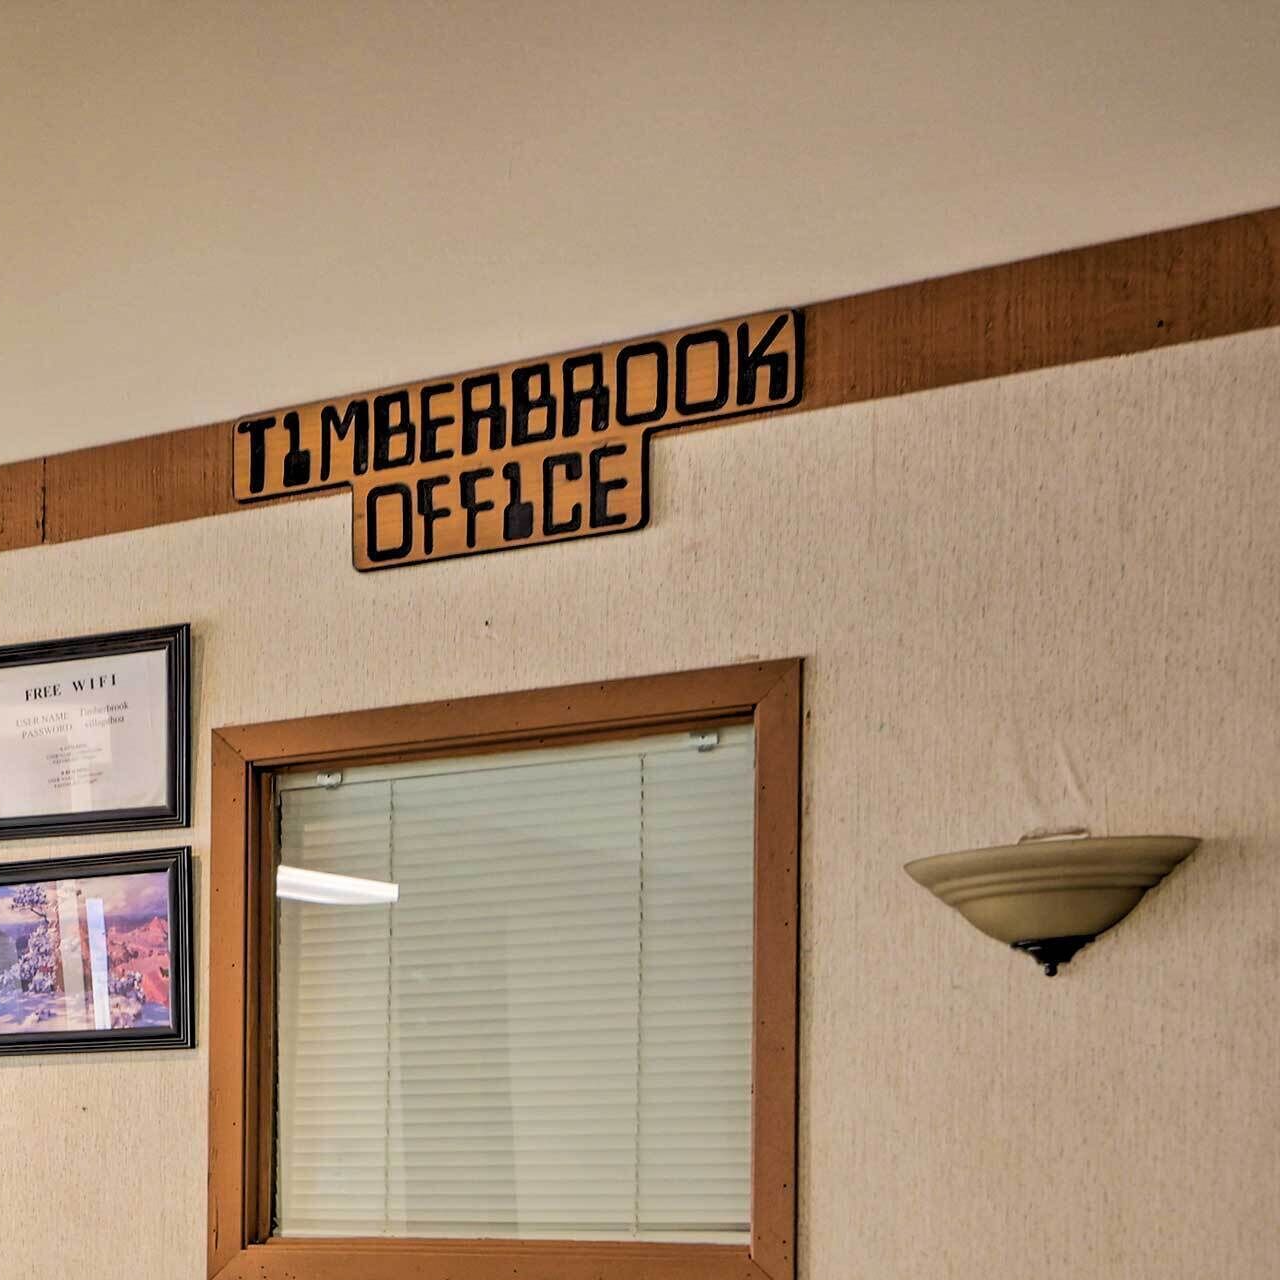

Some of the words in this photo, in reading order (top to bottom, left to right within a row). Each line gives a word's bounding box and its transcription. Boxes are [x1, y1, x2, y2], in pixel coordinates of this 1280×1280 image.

[237, 313, 791, 494] TIMBERBROOK
[366, 444, 628, 562] OFFICE
[25, 683, 62, 701] FREE
[22, 724, 73, 739] PASSWORD
